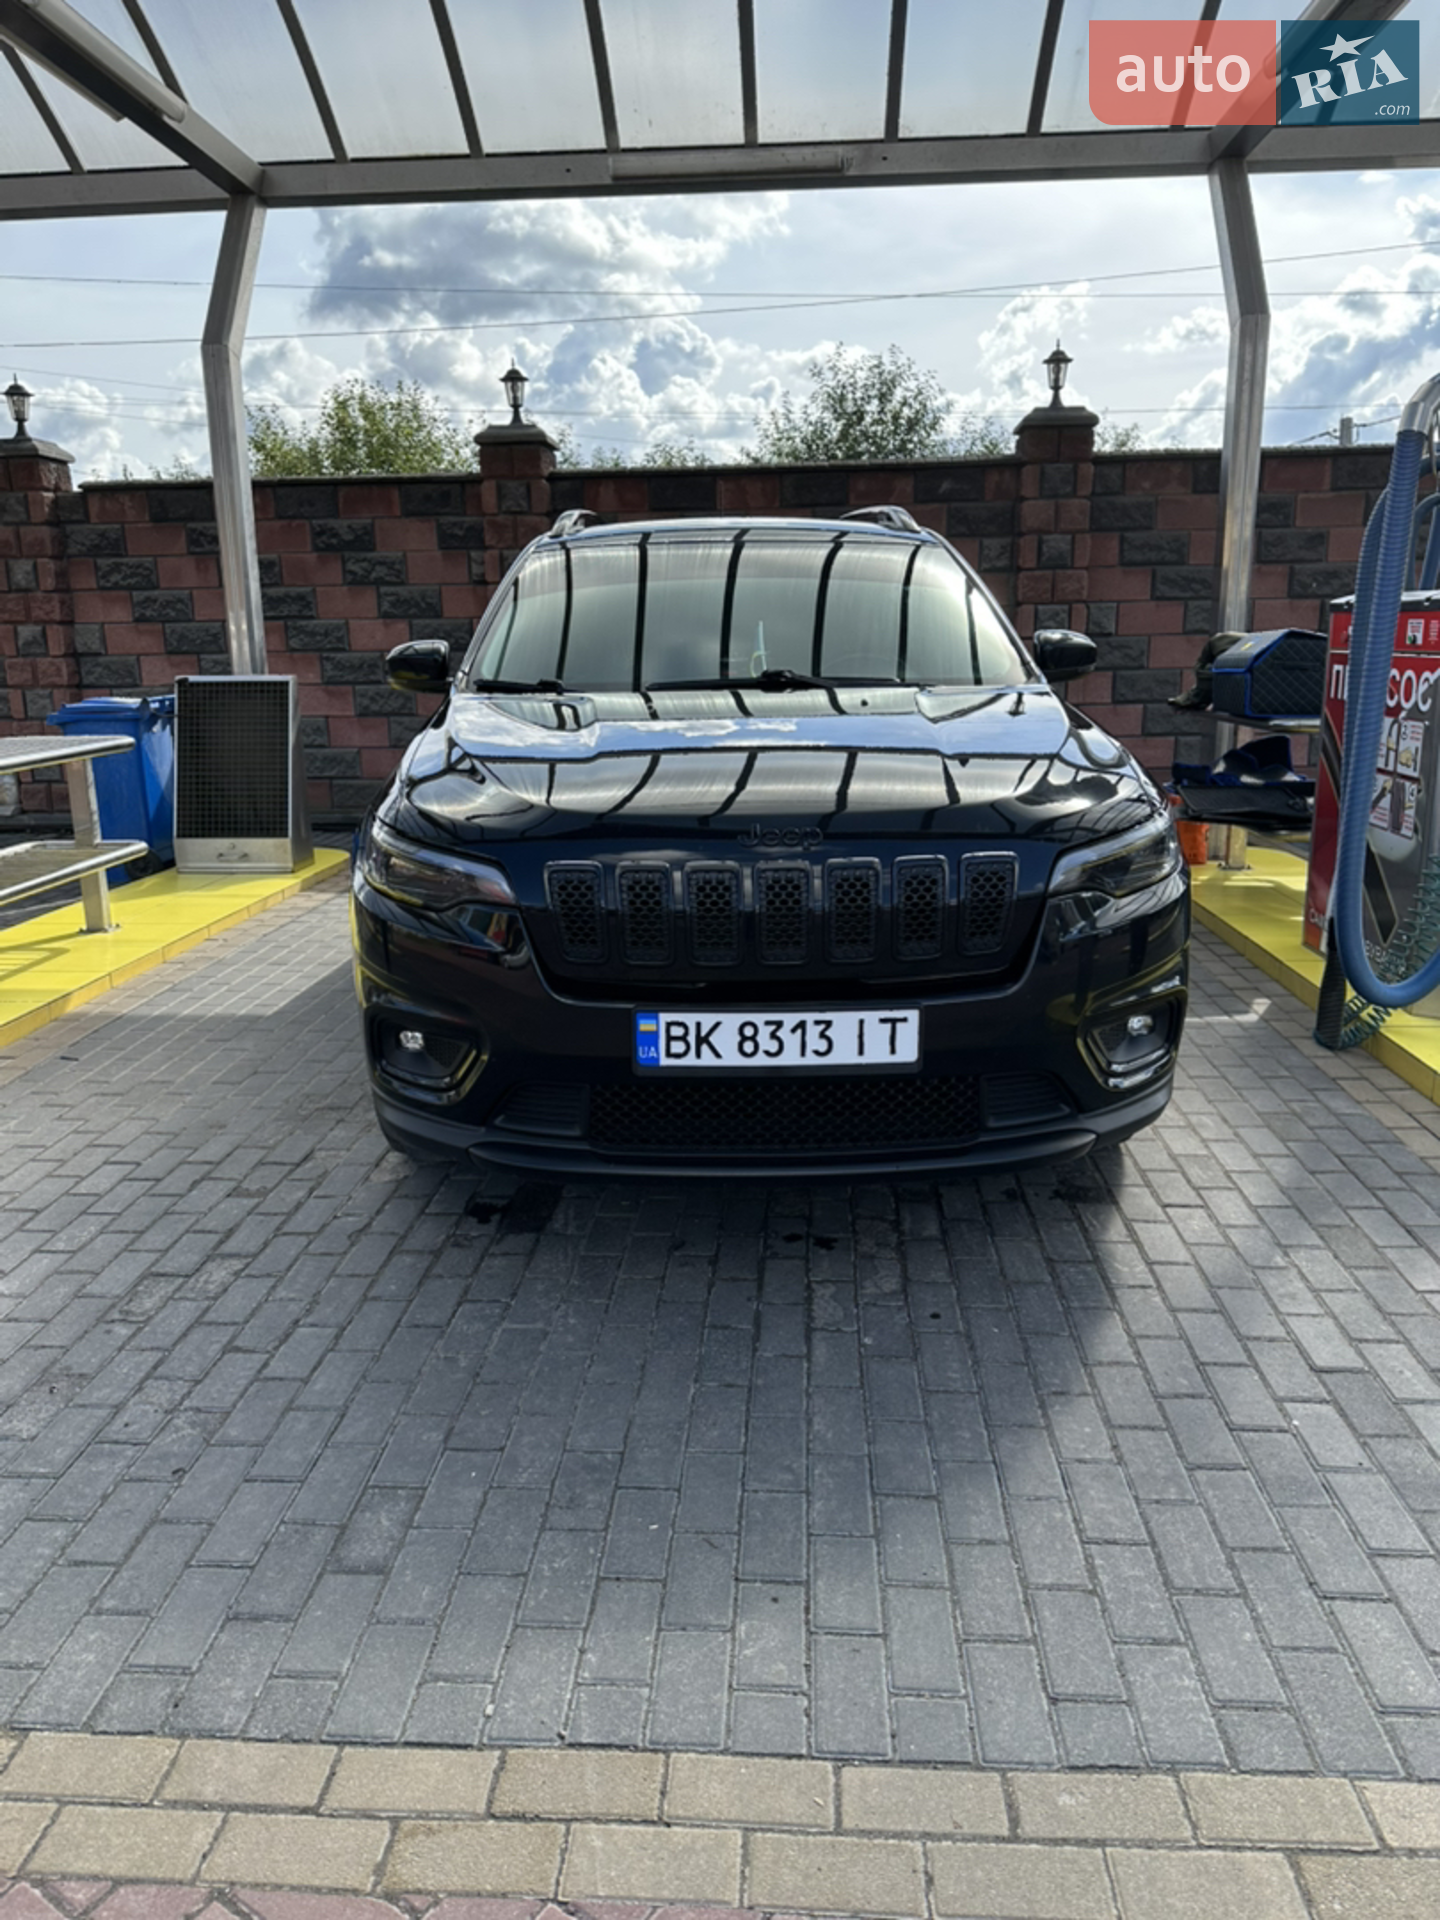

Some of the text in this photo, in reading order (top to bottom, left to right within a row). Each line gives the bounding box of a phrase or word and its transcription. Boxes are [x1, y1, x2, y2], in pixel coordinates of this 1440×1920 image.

[738, 823, 823, 850] Jeep
[639, 1046, 658, 1058] UA
[664, 1020, 723, 1059] BK
[737, 1019, 834, 1058] 8313
